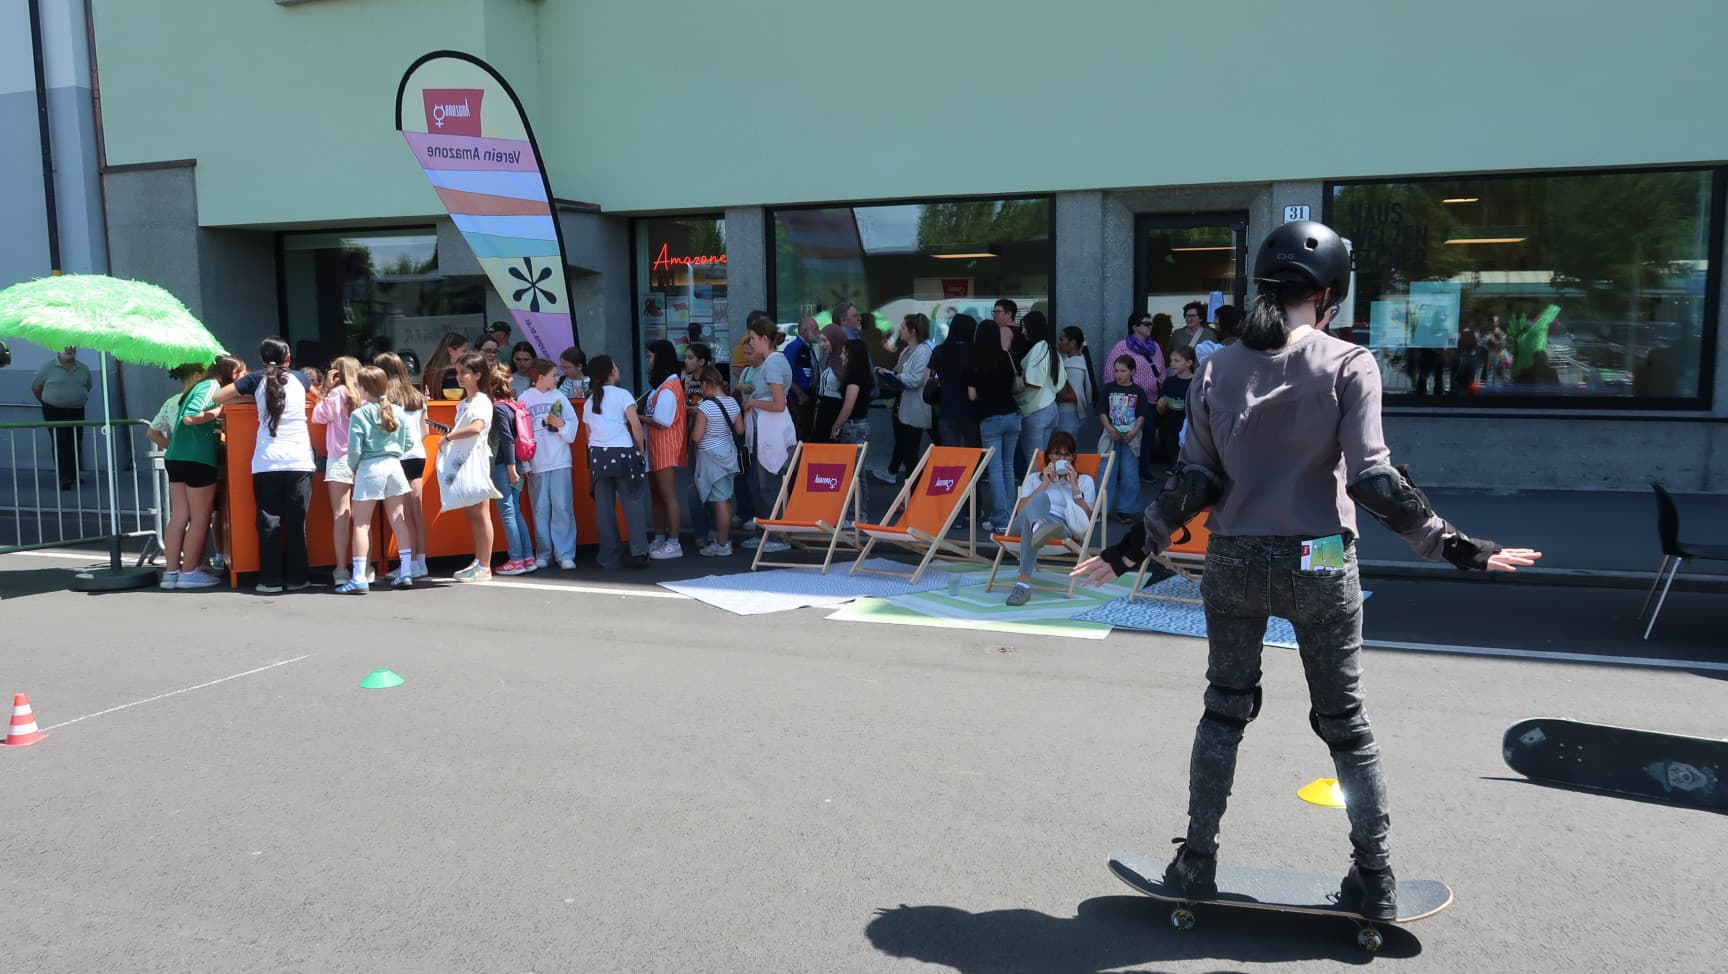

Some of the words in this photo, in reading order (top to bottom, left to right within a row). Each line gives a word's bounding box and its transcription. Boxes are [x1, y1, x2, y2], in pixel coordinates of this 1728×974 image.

[1290, 206, 1304, 220] 31
[1352, 202, 1402, 224] HAUS
[653, 242, 728, 271] Amazone
